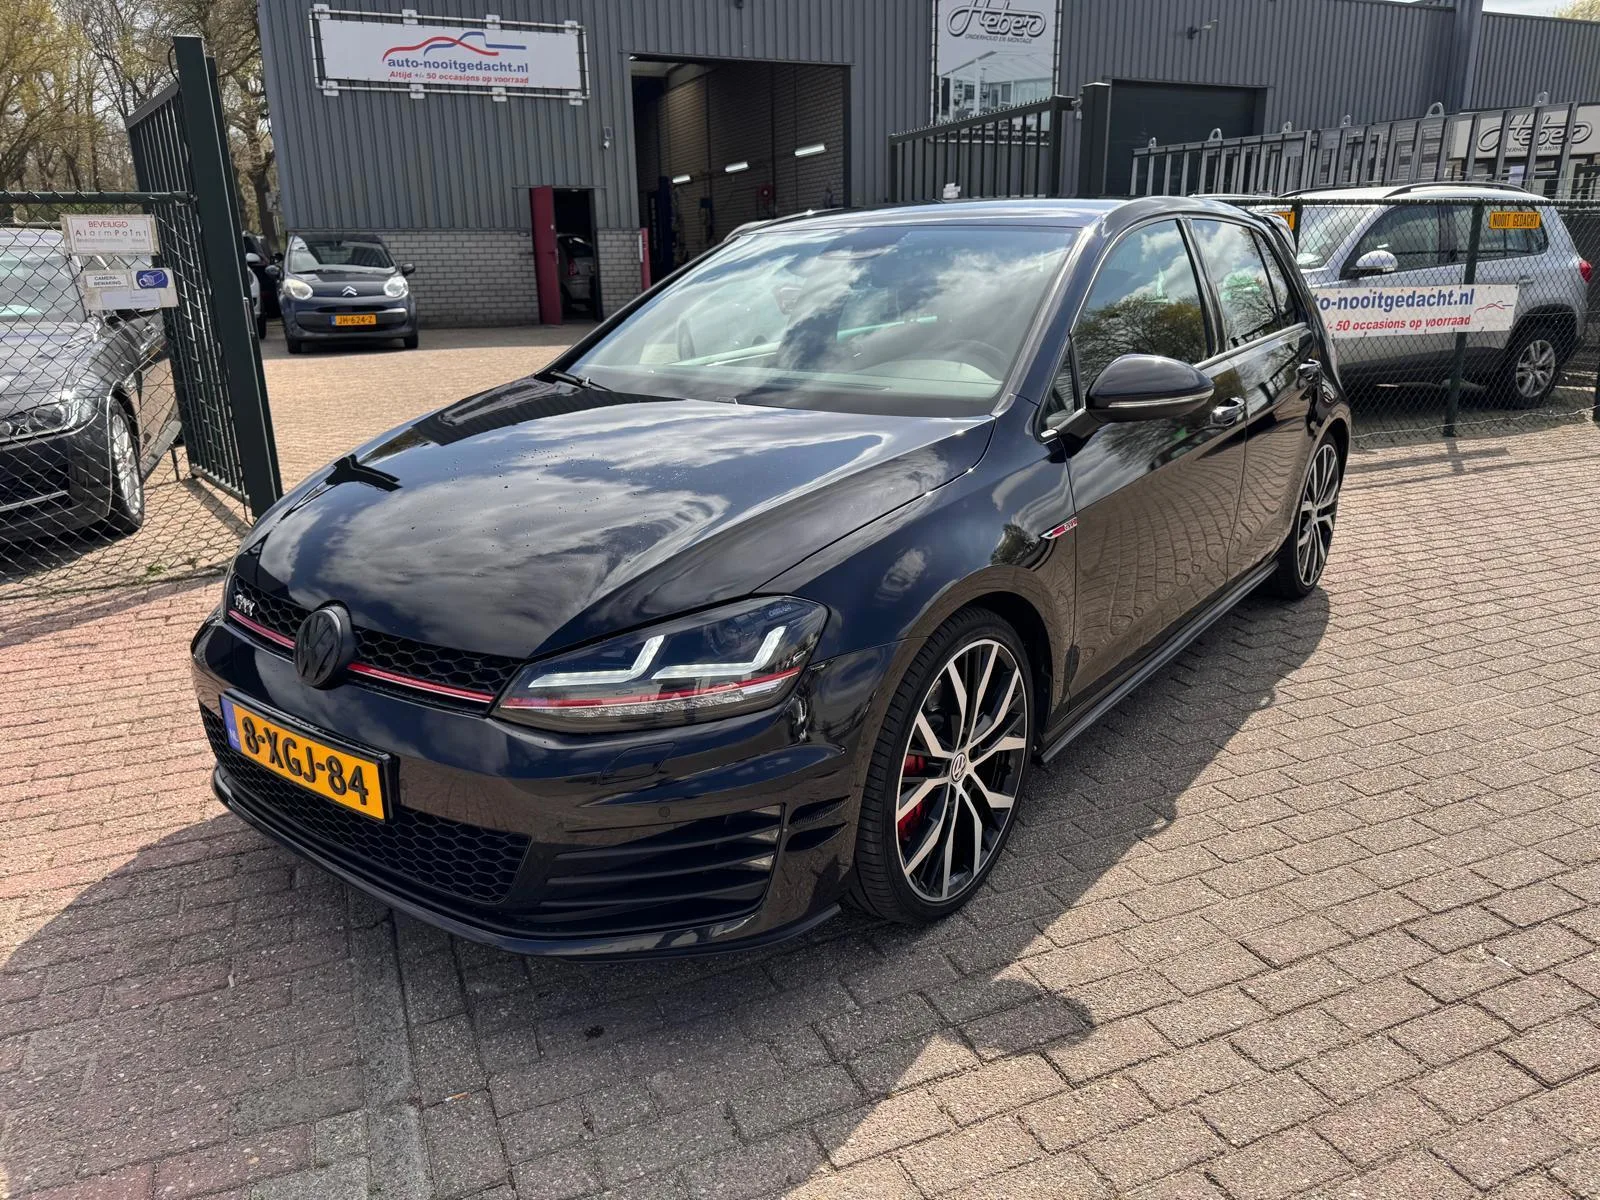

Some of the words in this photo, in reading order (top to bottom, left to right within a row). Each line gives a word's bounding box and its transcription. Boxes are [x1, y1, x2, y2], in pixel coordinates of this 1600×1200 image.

[387, 58, 529, 73] auto-nooitgedacht.nl
[389, 71, 412, 79] Altijd
[439, 73, 480, 82] occasions
[88, 220, 129, 228] BEVEILIGD
[1492, 213, 1511, 227] NOOIT
[1512, 213, 1538, 227] GEDACHT
[1336, 320, 1350, 331] 50
[1353, 317, 1406, 330] occasions
[1409, 319, 1422, 330] op
[1426, 314, 1471, 327] voorraad
[242, 716, 369, 806] 8-XGJ-84
